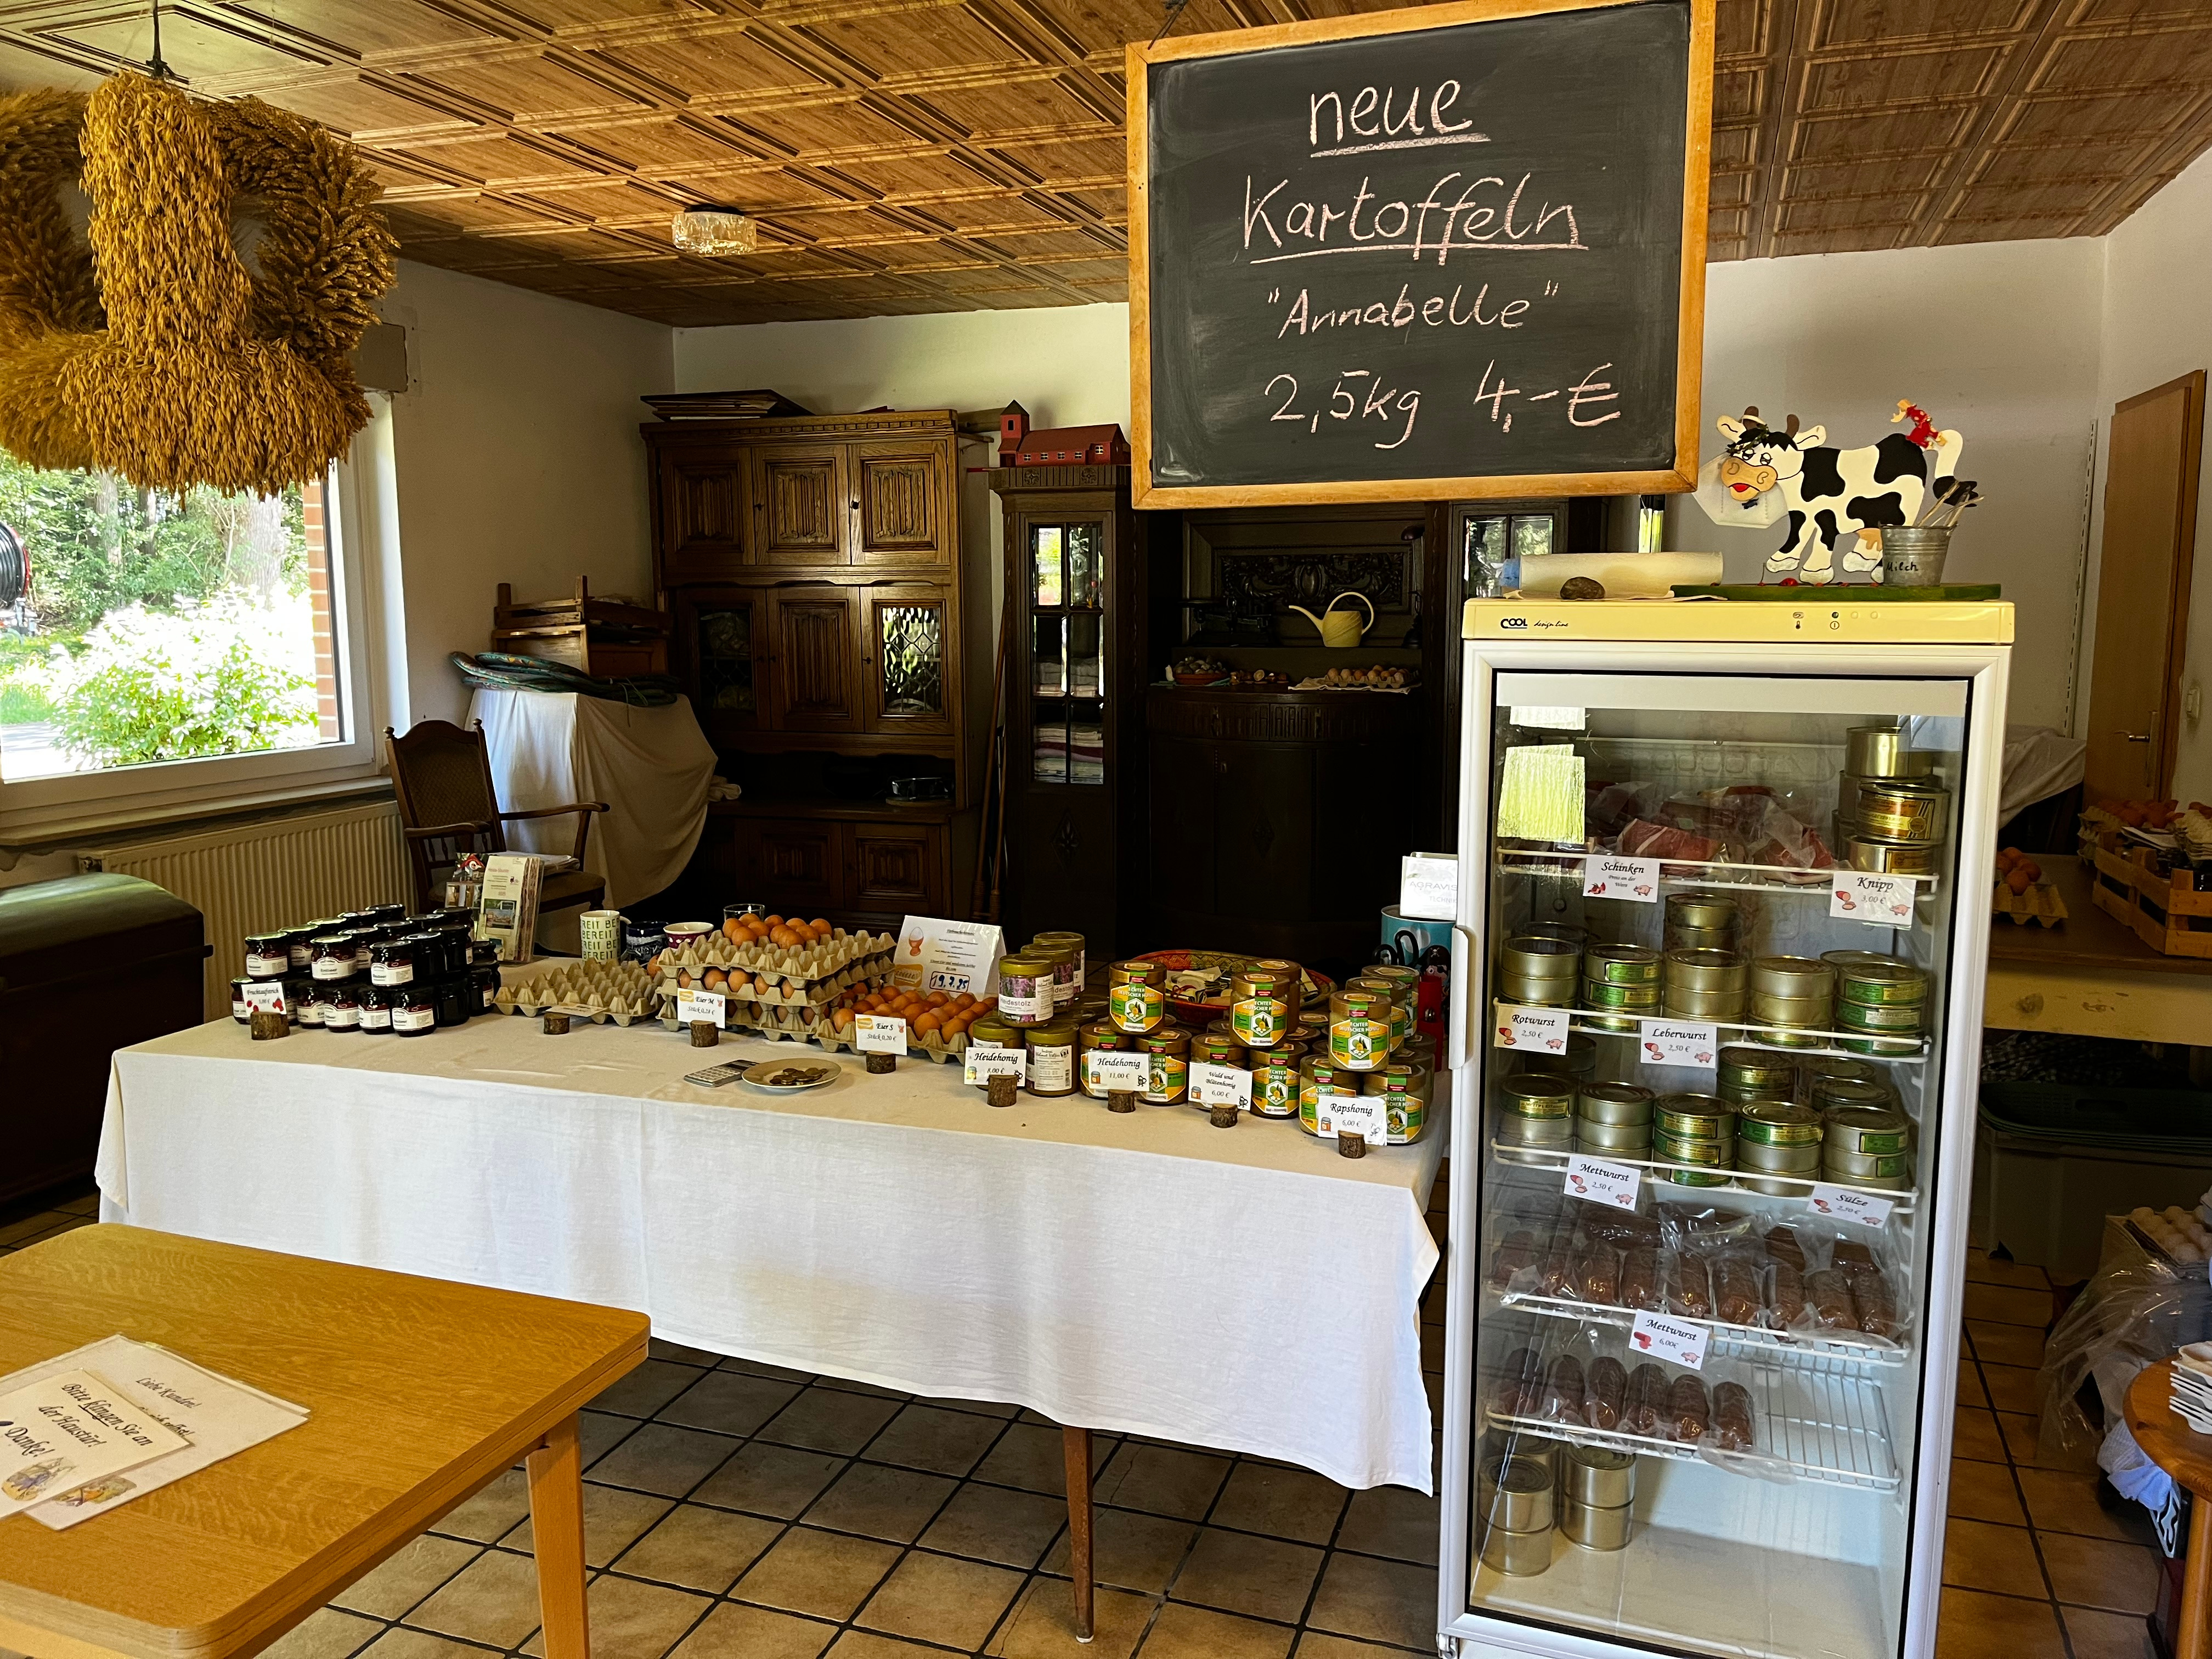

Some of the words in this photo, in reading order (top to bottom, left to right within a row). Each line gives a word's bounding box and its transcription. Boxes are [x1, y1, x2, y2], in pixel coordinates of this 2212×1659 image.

[1310, 80, 1472, 146] neue
[1243, 172, 1579, 266] Kartoffeln
[1265, 370, 1421, 449] 2,5kg
[1886, 561, 1919, 572] Milch
[1500, 618, 1527, 629] COOL
[1601, 862, 1644, 874] Schinken
[1409, 881, 1458, 891] AGRAVIS
[1857, 877, 1894, 893] Knipp
[1861, 895, 1878, 904] 3,00
[1000, 997, 1031, 1006] Heidestolz
[1512, 1014, 1555, 1026] Rotwurst
[1521, 1030, 1537, 1038] 2,50
[1652, 1028, 1707, 1040] Leberwurst
[974, 1052, 1018, 1064] Heidehonig
[1097, 1058, 1141, 1069] Heidehonig
[1206, 1079, 1236, 1089] Blütenhonig
[1330, 1103, 1373, 1116] Rapshonig
[1579, 1164, 1629, 1182] Mettwurst
[1592, 1181, 1607, 1189] 2,50
[1646, 1319, 1697, 1340] Mettwurst
[136, 1378, 165, 1391] Liebe
[158, 1388, 202, 1408] Kunden!
[61, 1383, 92, 1402] Bitte
[115, 1424, 142, 1436] Sie
[132, 1435, 154, 1446] an
[38, 1406, 64, 1418] der
[52, 1415, 108, 1448] Haustür!
[4, 1427, 55, 1458] Danke!
